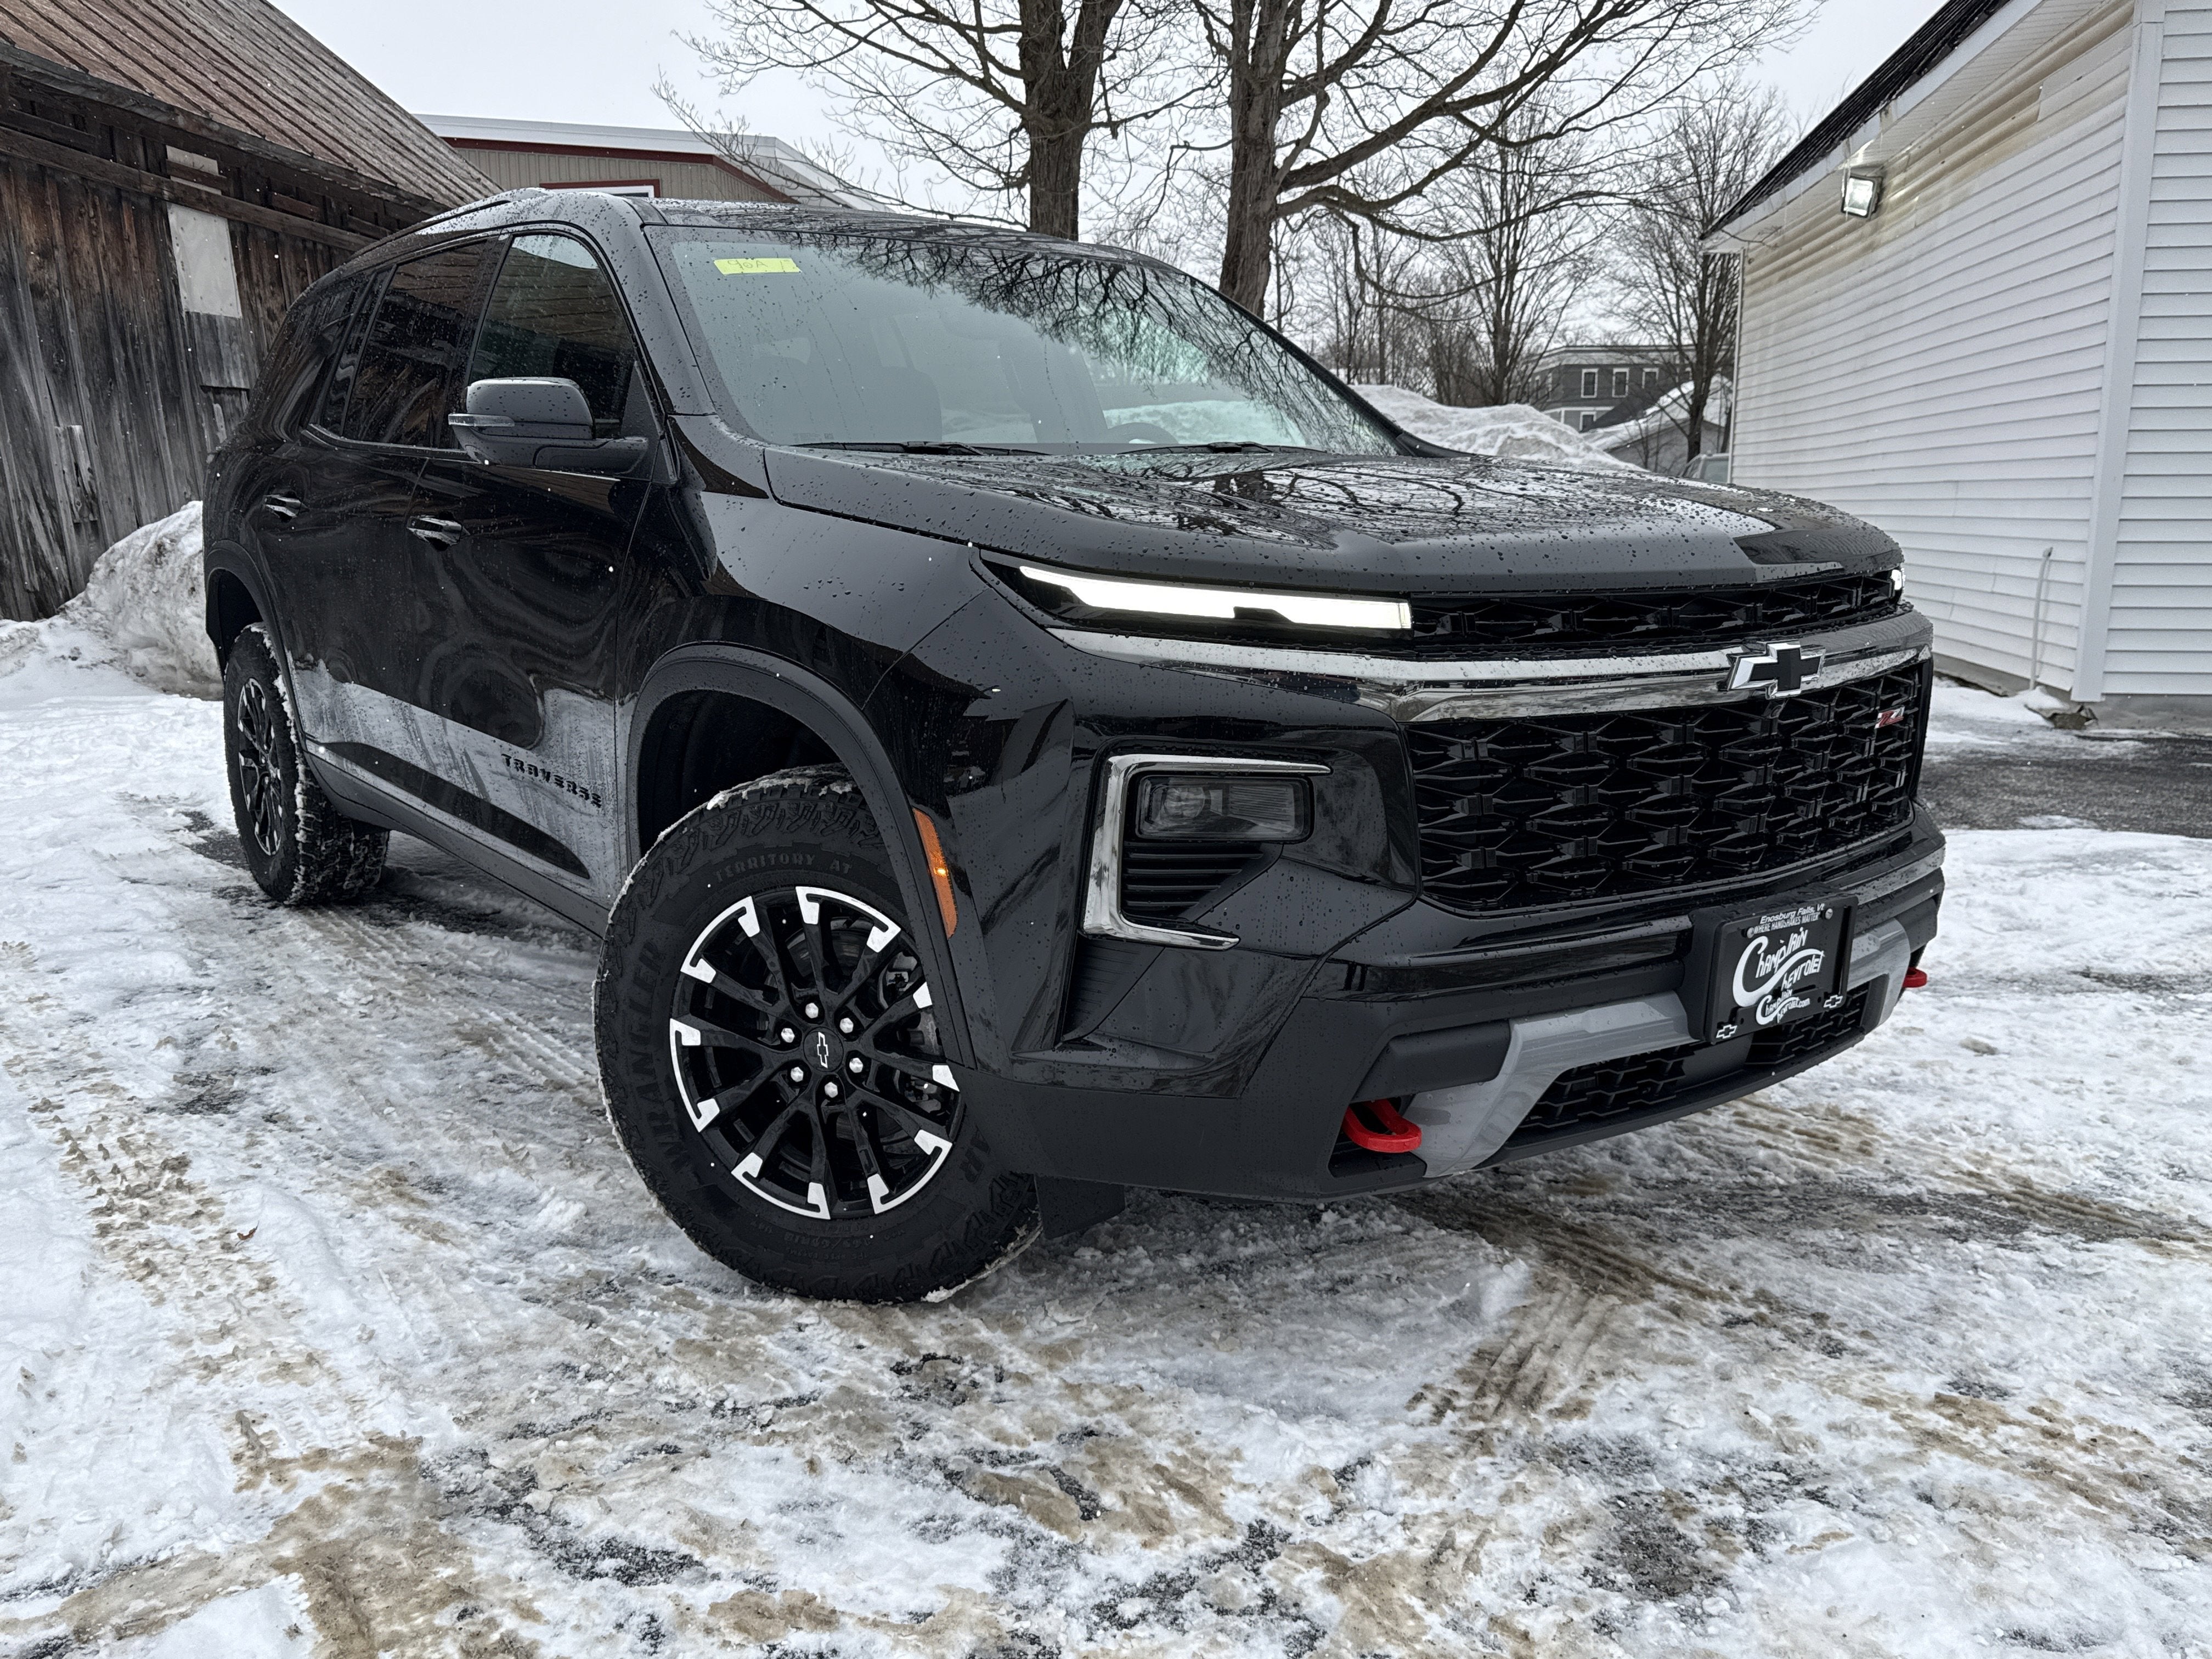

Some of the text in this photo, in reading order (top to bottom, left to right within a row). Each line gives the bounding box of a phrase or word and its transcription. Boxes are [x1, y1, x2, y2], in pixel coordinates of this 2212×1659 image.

[1875, 705, 1905, 729] Z71
[501, 753, 601, 808] TRAVERSE
[715, 852, 853, 883] TERRITORY AT
[1754, 923, 1770, 934] WHERE
[1771, 916, 1801, 930] HANDSHAKES
[1759, 911, 1796, 925] Enosburg
[1797, 906, 1815, 916] Falls,
